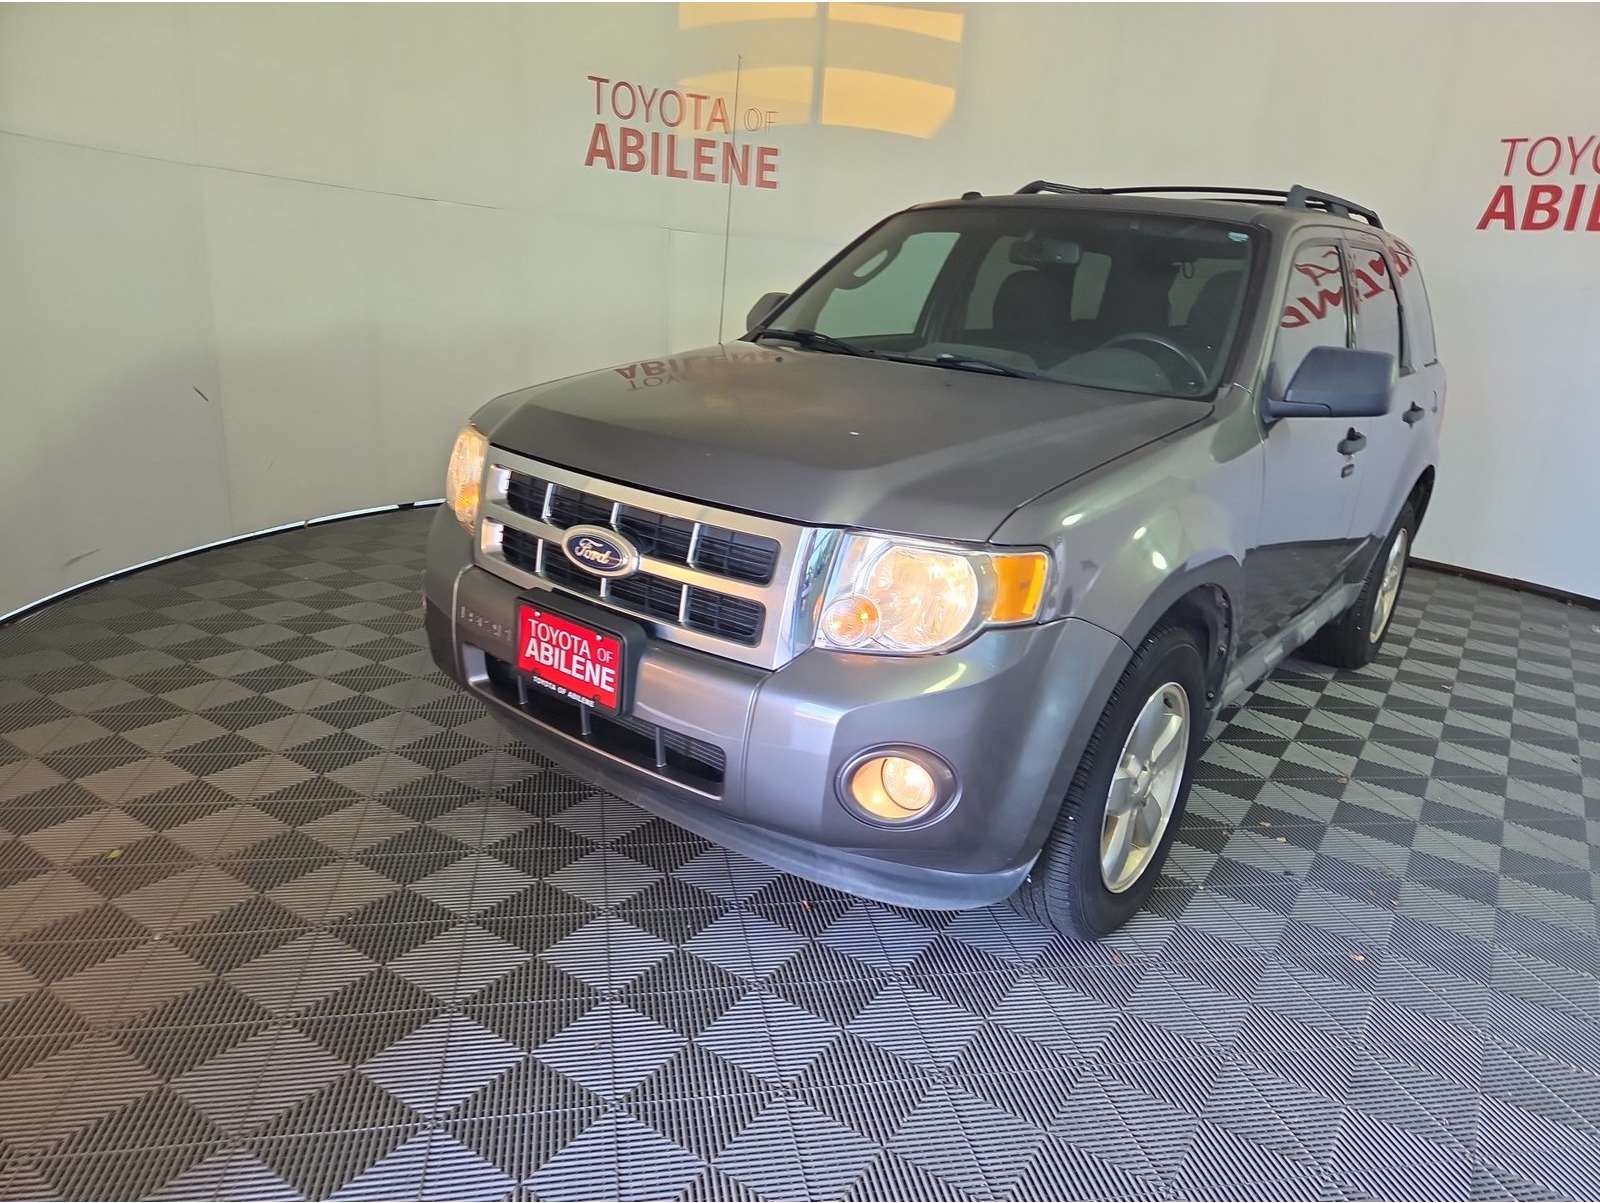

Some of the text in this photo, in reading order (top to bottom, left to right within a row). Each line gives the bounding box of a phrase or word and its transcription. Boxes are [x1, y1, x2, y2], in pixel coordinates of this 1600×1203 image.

[587, 75, 779, 134] TOYOTA OF
[584, 122, 778, 189] ABILENE
[1500, 135, 1600, 177] TOY
[575, 538, 611, 564] Ford
[525, 637, 616, 693] ABILENE
[528, 618, 614, 663] TOYOTA OF
